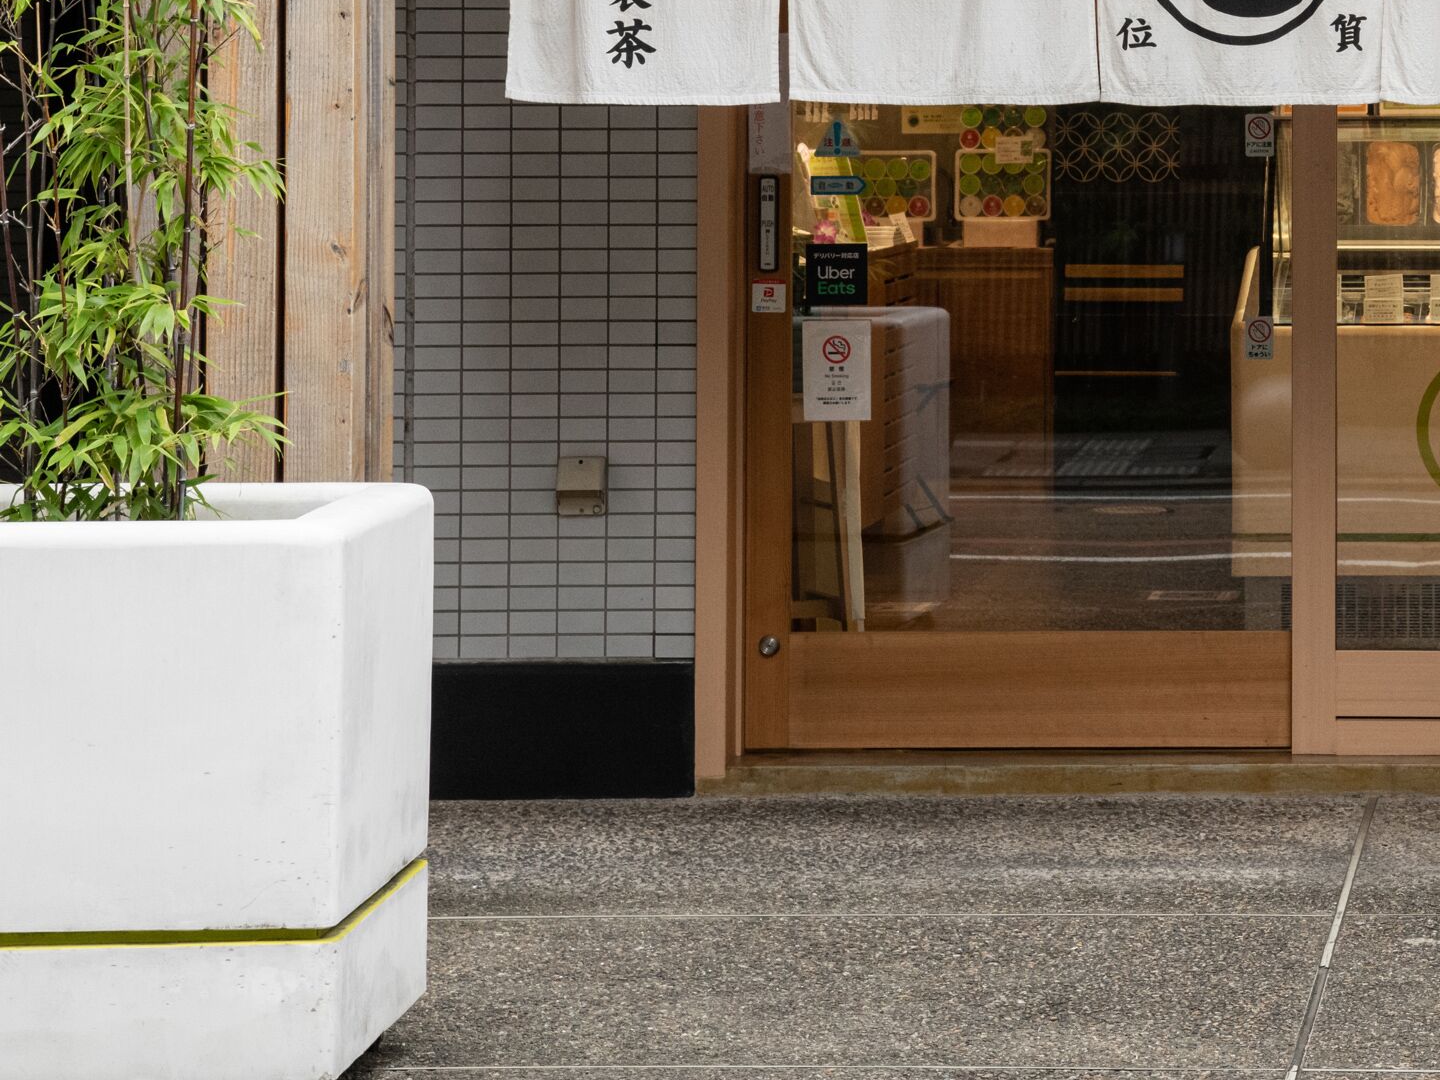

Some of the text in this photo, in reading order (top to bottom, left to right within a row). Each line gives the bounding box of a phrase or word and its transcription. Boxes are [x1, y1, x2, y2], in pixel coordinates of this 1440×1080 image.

[1116, 17, 1157, 51] 位
[1330, 13, 1368, 53] 質
[817, 266, 855, 279] Uber
[817, 281, 856, 295] Eats
